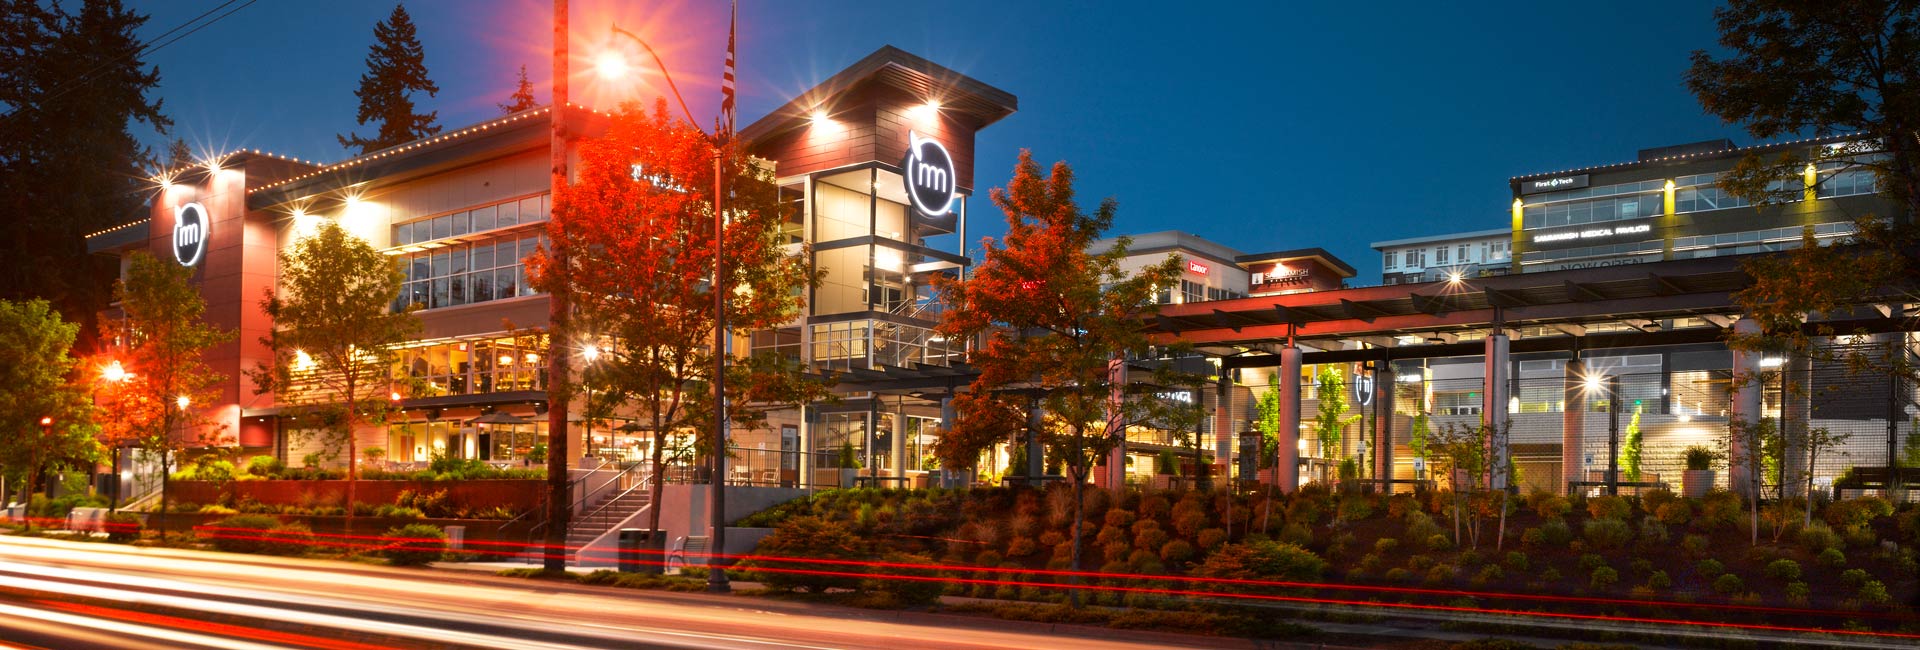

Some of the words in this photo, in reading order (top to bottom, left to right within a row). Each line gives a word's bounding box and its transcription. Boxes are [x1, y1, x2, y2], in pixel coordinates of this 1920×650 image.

[1535, 180, 1551, 188] First
[1534, 232, 1579, 242] SAMMAMISH
[1581, 229, 1613, 238] MEDICAL
[1616, 225, 1650, 234] PAVILION
